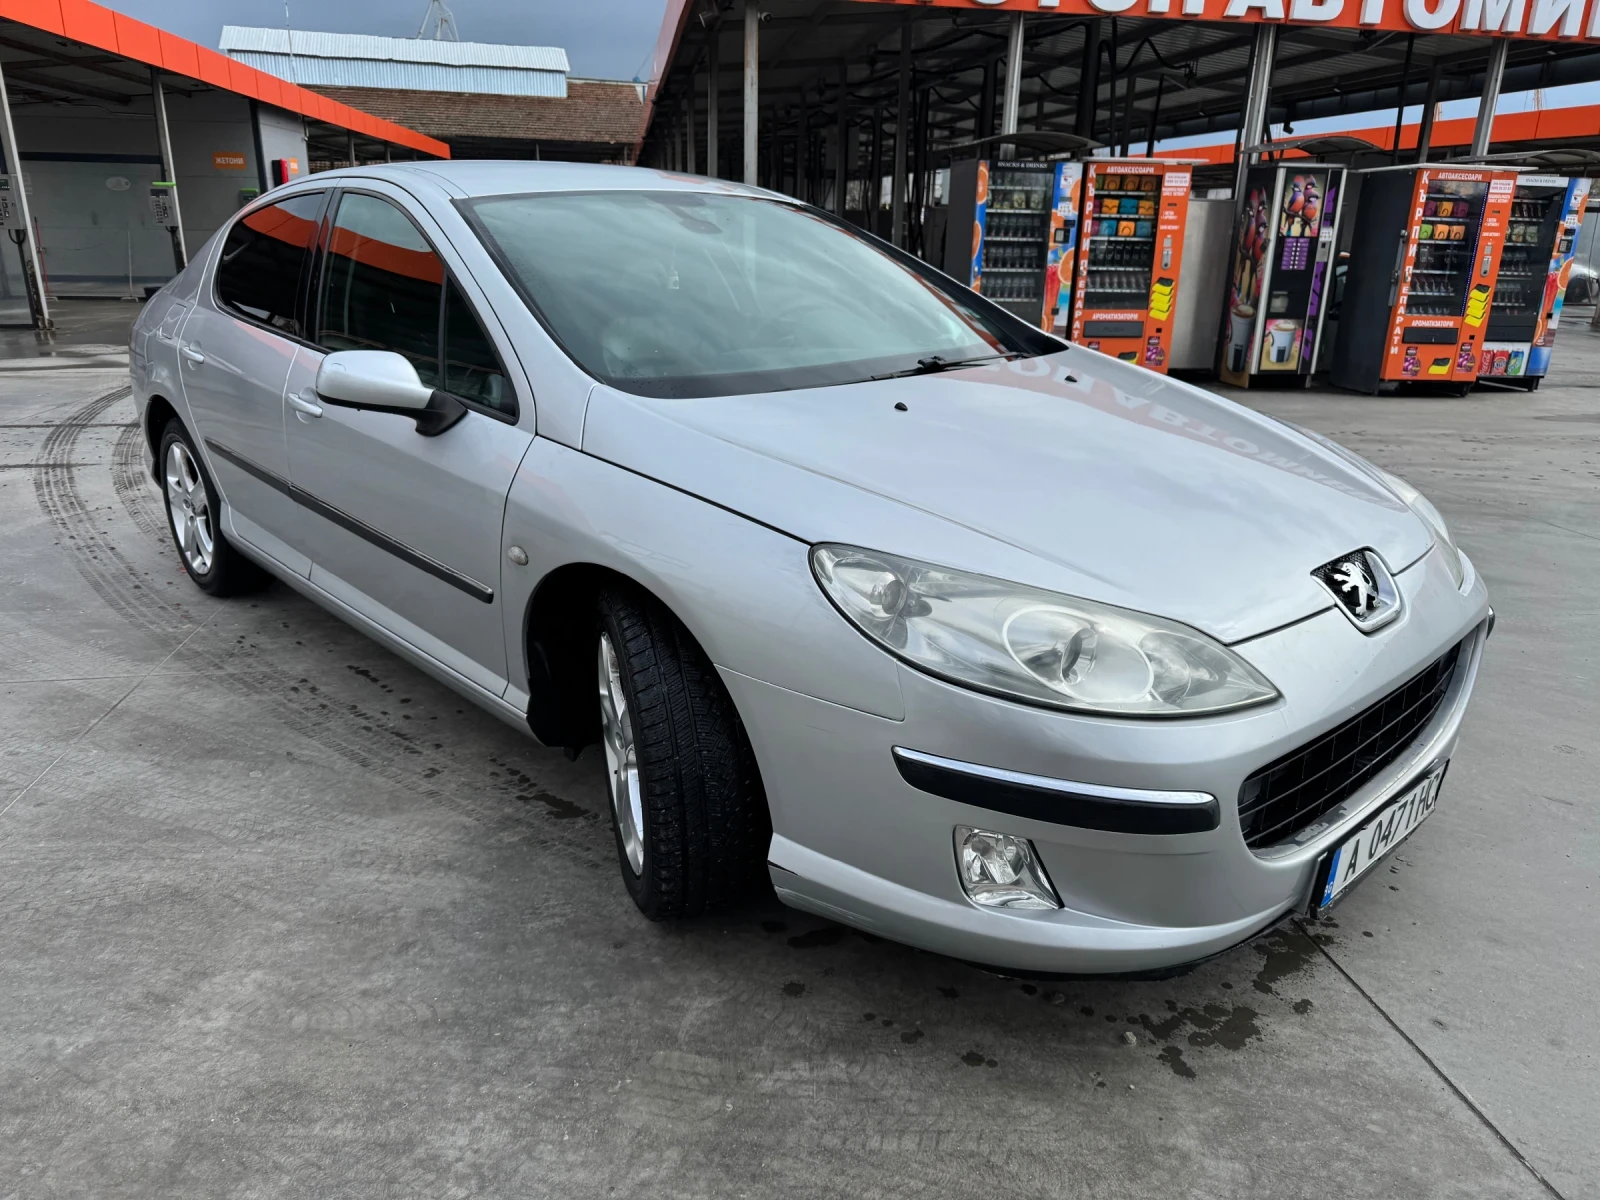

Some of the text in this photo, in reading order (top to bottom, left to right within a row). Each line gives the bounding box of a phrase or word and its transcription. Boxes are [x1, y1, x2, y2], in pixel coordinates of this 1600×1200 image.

[1106, 165, 1155, 174] АВТОАКСЕСОАРИ
[1438, 172, 1483, 180] АВТОАКСЕСОАРИ
[1343, 838, 1360, 882] A
